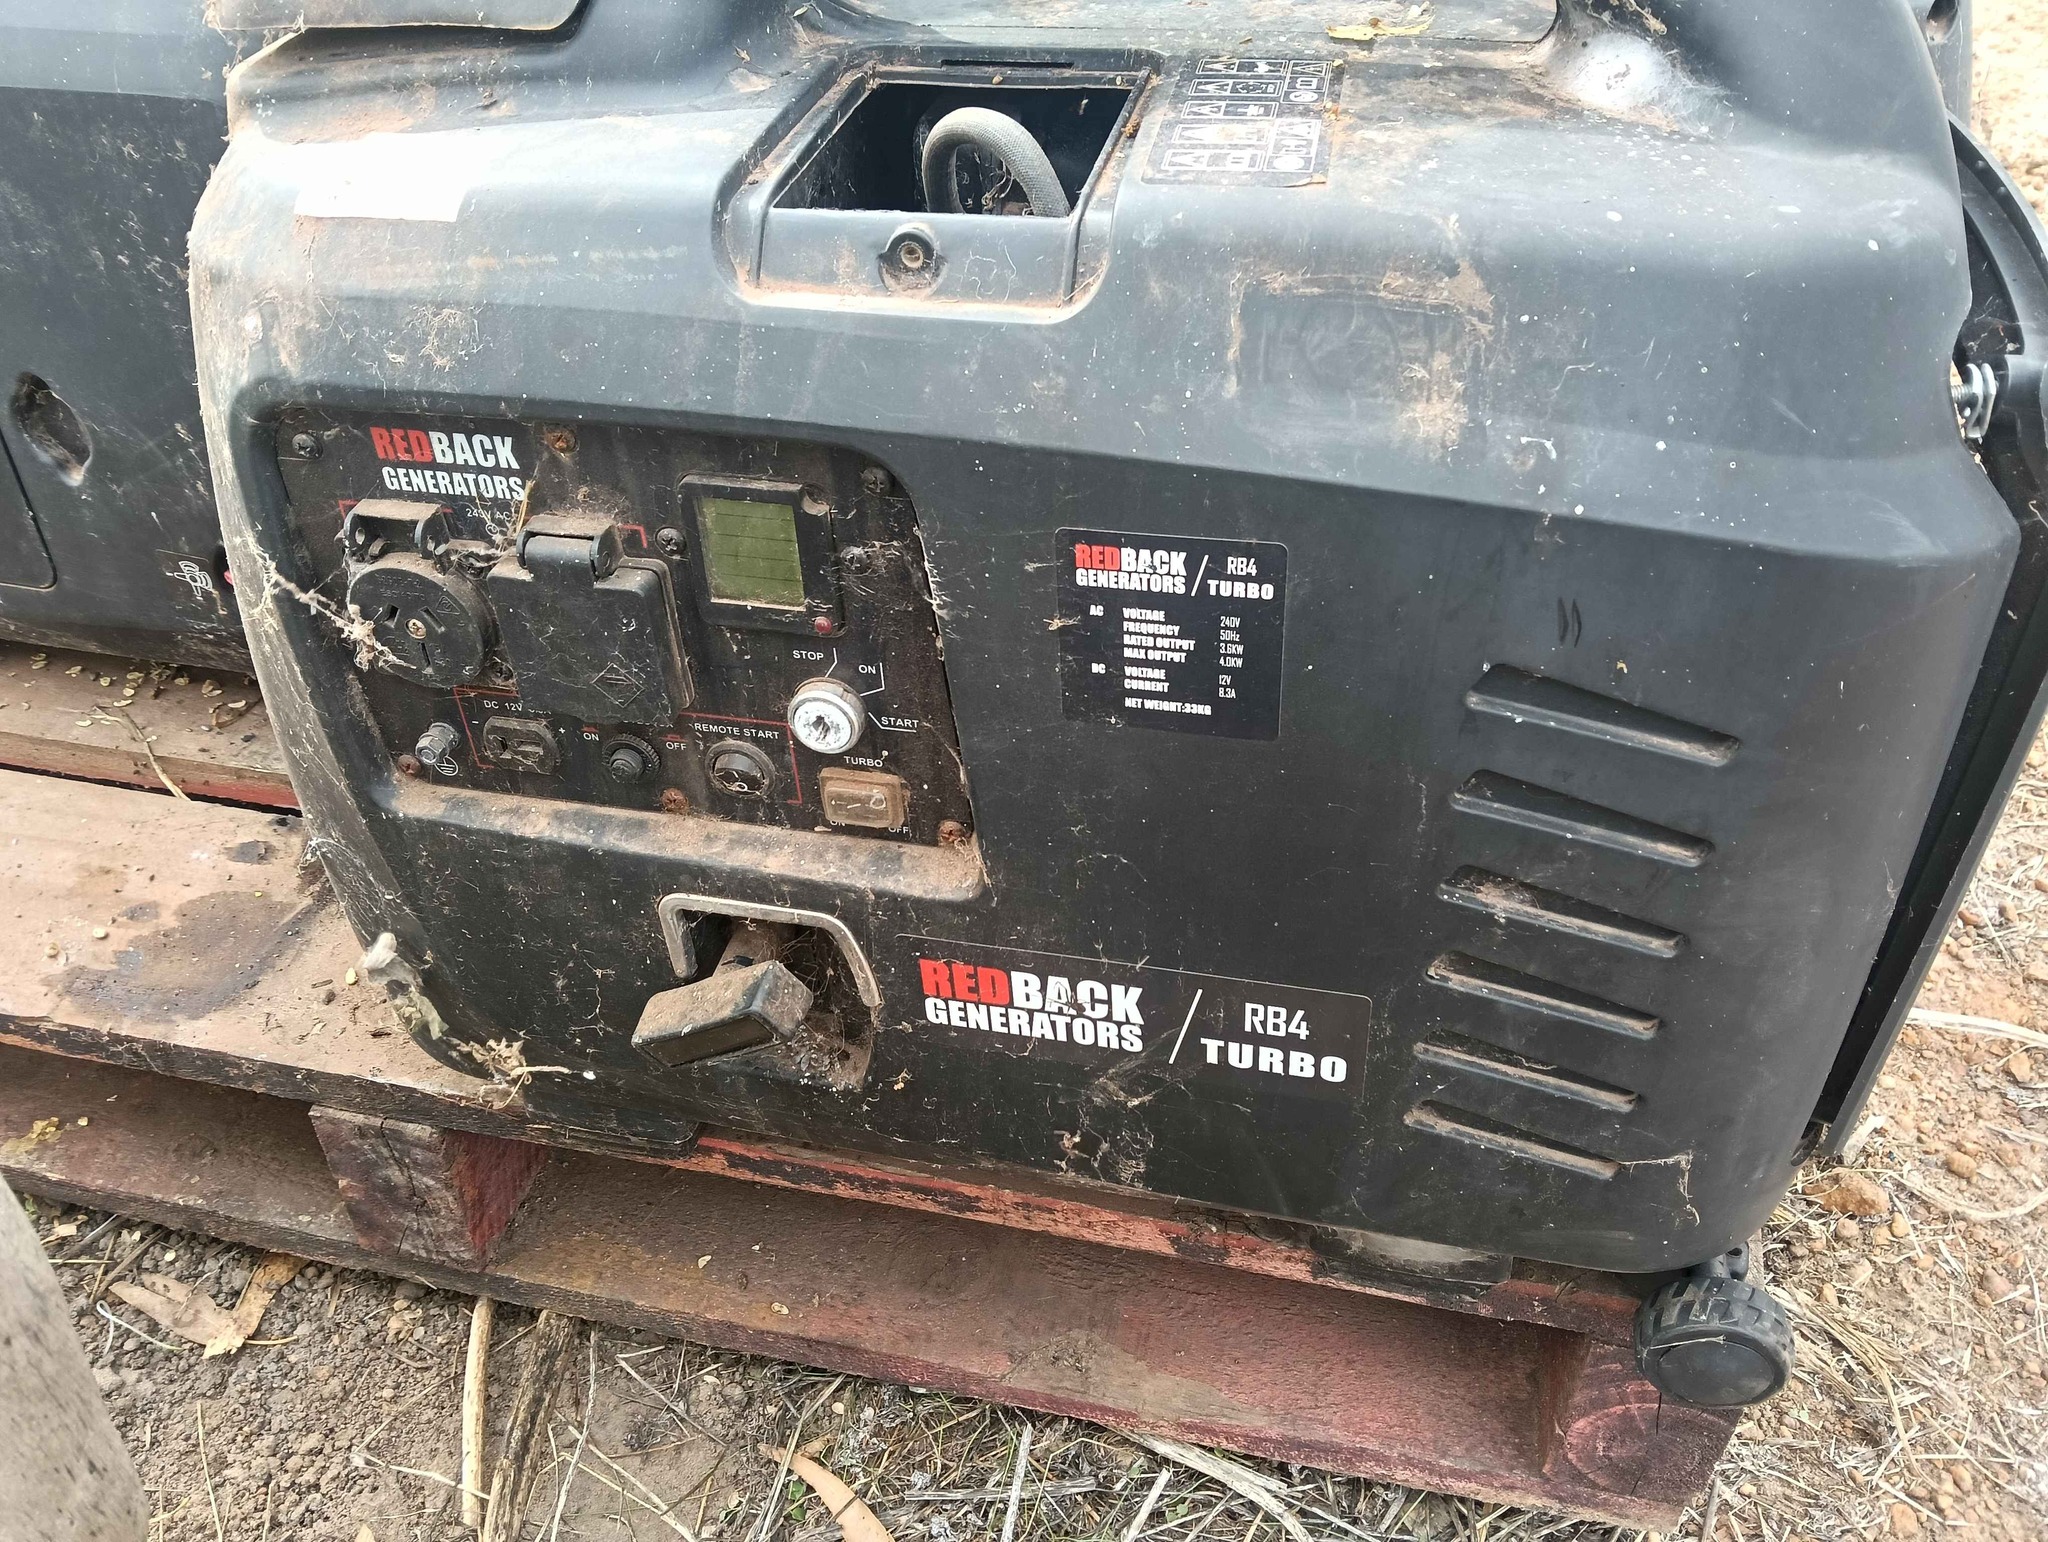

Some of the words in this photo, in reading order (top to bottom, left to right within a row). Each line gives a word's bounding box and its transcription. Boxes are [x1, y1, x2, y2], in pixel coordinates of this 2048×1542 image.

[371, 427, 520, 470] REDBACK
[382, 466, 525, 501] GENERATORS
[495, 511, 511, 520] AC
[1075, 544, 1187, 576] REDBACK
[1227, 556, 1258, 577] RB4
[1075, 568, 1186, 595] GENERATORS
[1207, 579, 1275, 600] TURBO
[1090, 605, 1104, 616] AC
[1122, 607, 1165, 622] VOLTAGE
[1220, 616, 1241, 628] 240V
[1123, 621, 1180, 636] FREQUENCY
[1219, 629, 1240, 641] 50Hz
[1123, 634, 1154, 647] RATED
[1155, 637, 1196, 651] OUTPUT
[1219, 643, 1244, 655] 3.6KW
[792, 649, 824, 662] STOP
[1123, 647, 1146, 659] MAX
[1147, 649, 1187, 663] OUTPUT
[1219, 656, 1244, 668] 4.0KW
[858, 663, 876, 675] ON
[1091, 663, 1106, 675] DC
[1124, 665, 1166, 680] VOLTAGE
[1218, 674, 1232, 686] 12V
[1124, 679, 1170, 693] CURRENT
[1218, 687, 1236, 699] 8.3A
[483, 700, 499, 709] DC
[504, 702, 523, 712] 12V
[1125, 697, 1142, 708] NET
[694, 722, 741, 737] REMOTE
[743, 727, 779, 740] START
[881, 716, 919, 729] START
[583, 732, 599, 741] ON
[665, 741, 687, 751] OFF
[843, 755, 883, 768] TURBO
[919, 958, 1145, 1025] REDBACK
[924, 996, 1144, 1053] GENERATORS
[1244, 1002, 1310, 1040] RB4
[1200, 1038, 1347, 1083] TURBO
